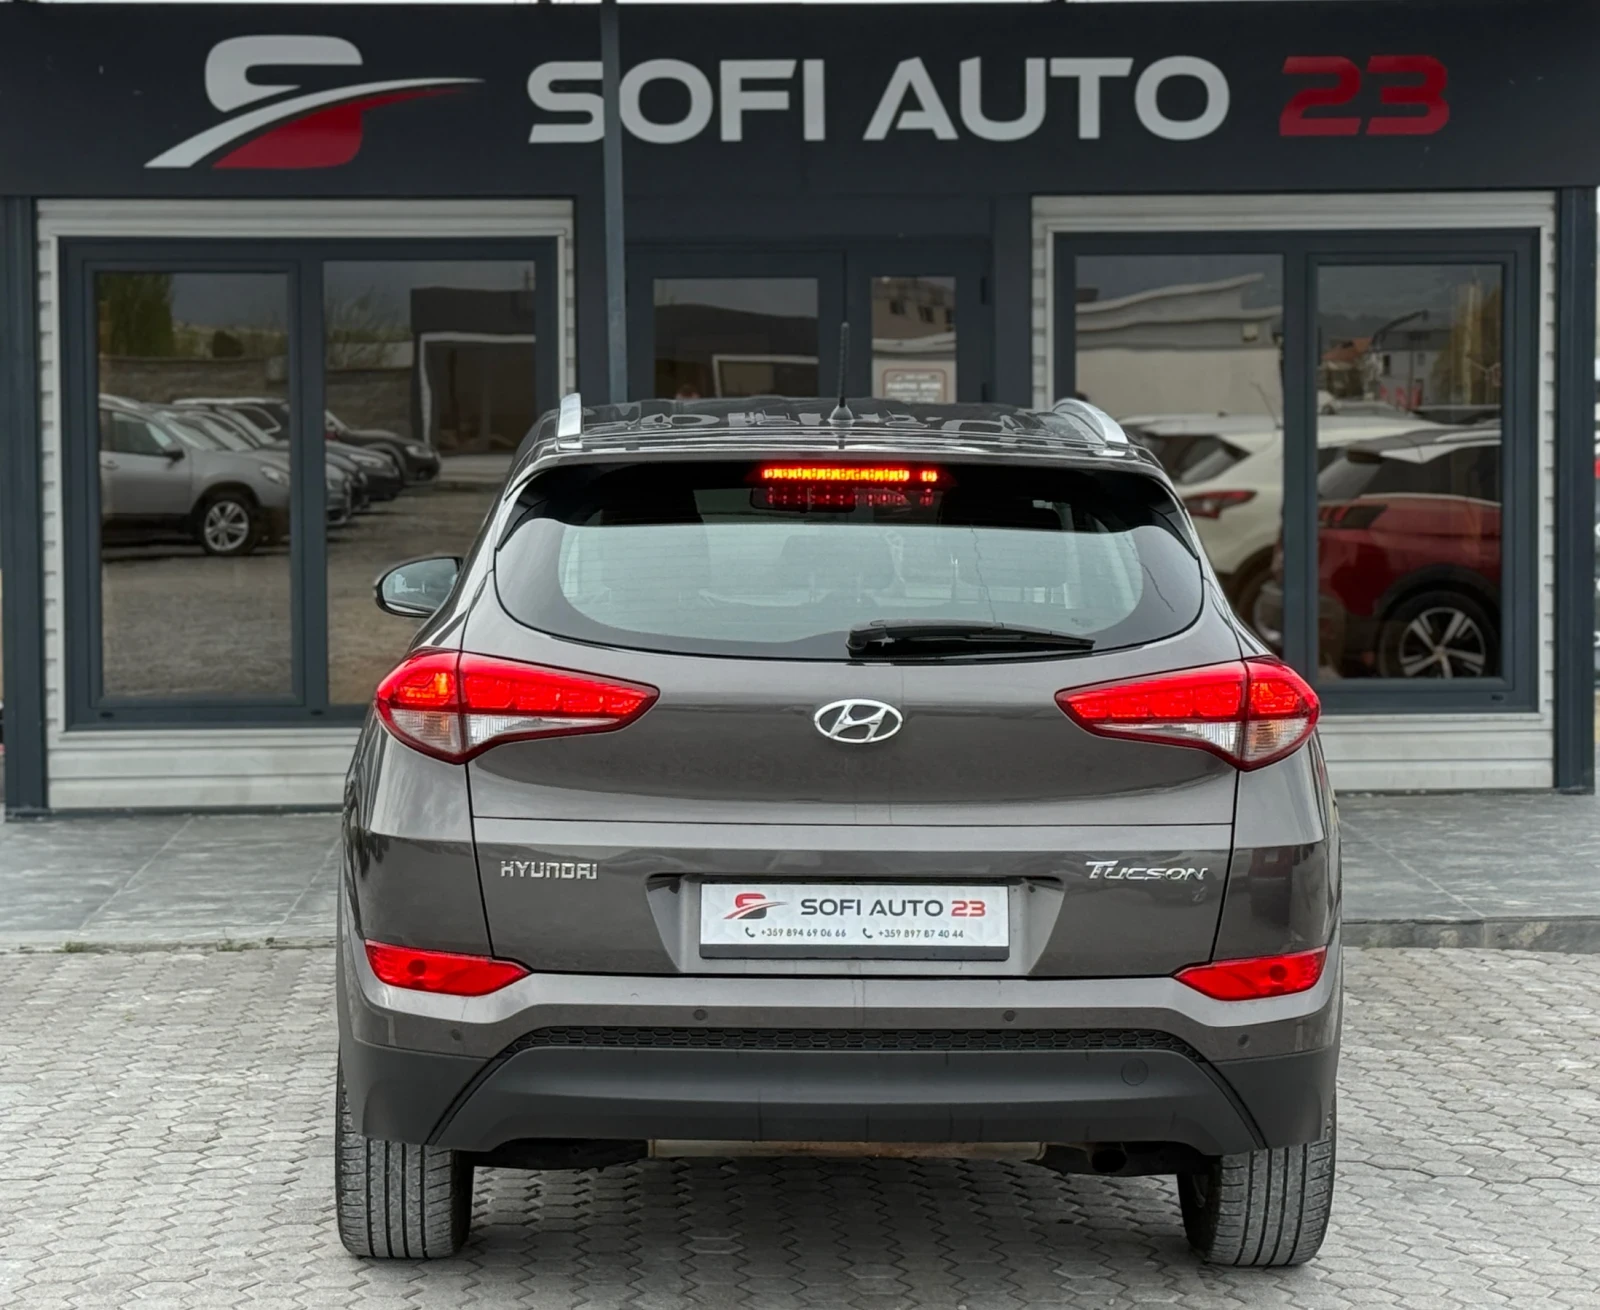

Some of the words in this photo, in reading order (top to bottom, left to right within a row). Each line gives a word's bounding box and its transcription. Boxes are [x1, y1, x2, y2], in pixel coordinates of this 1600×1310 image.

[528, 59, 825, 143] SOFI
[864, 56, 1230, 140] AUTO
[1280, 56, 1450, 136] 23
[500, 860, 598, 880] HYUNDAI
[800, 898, 861, 916] SOFI
[869, 899, 944, 917] AUTO
[951, 900, 986, 917] 23
[761, 928, 784, 937] +359
[786, 928, 804, 937] 894
[806, 928, 818, 937] 69
[820, 928, 832, 937] 06
[835, 928, 847, 938] 66
[878, 929, 901, 938] +359
[904, 929, 921, 938] 897
[924, 929, 935, 938] 87
[938, 929, 950, 938] 40
[952, 930, 964, 938] 44
